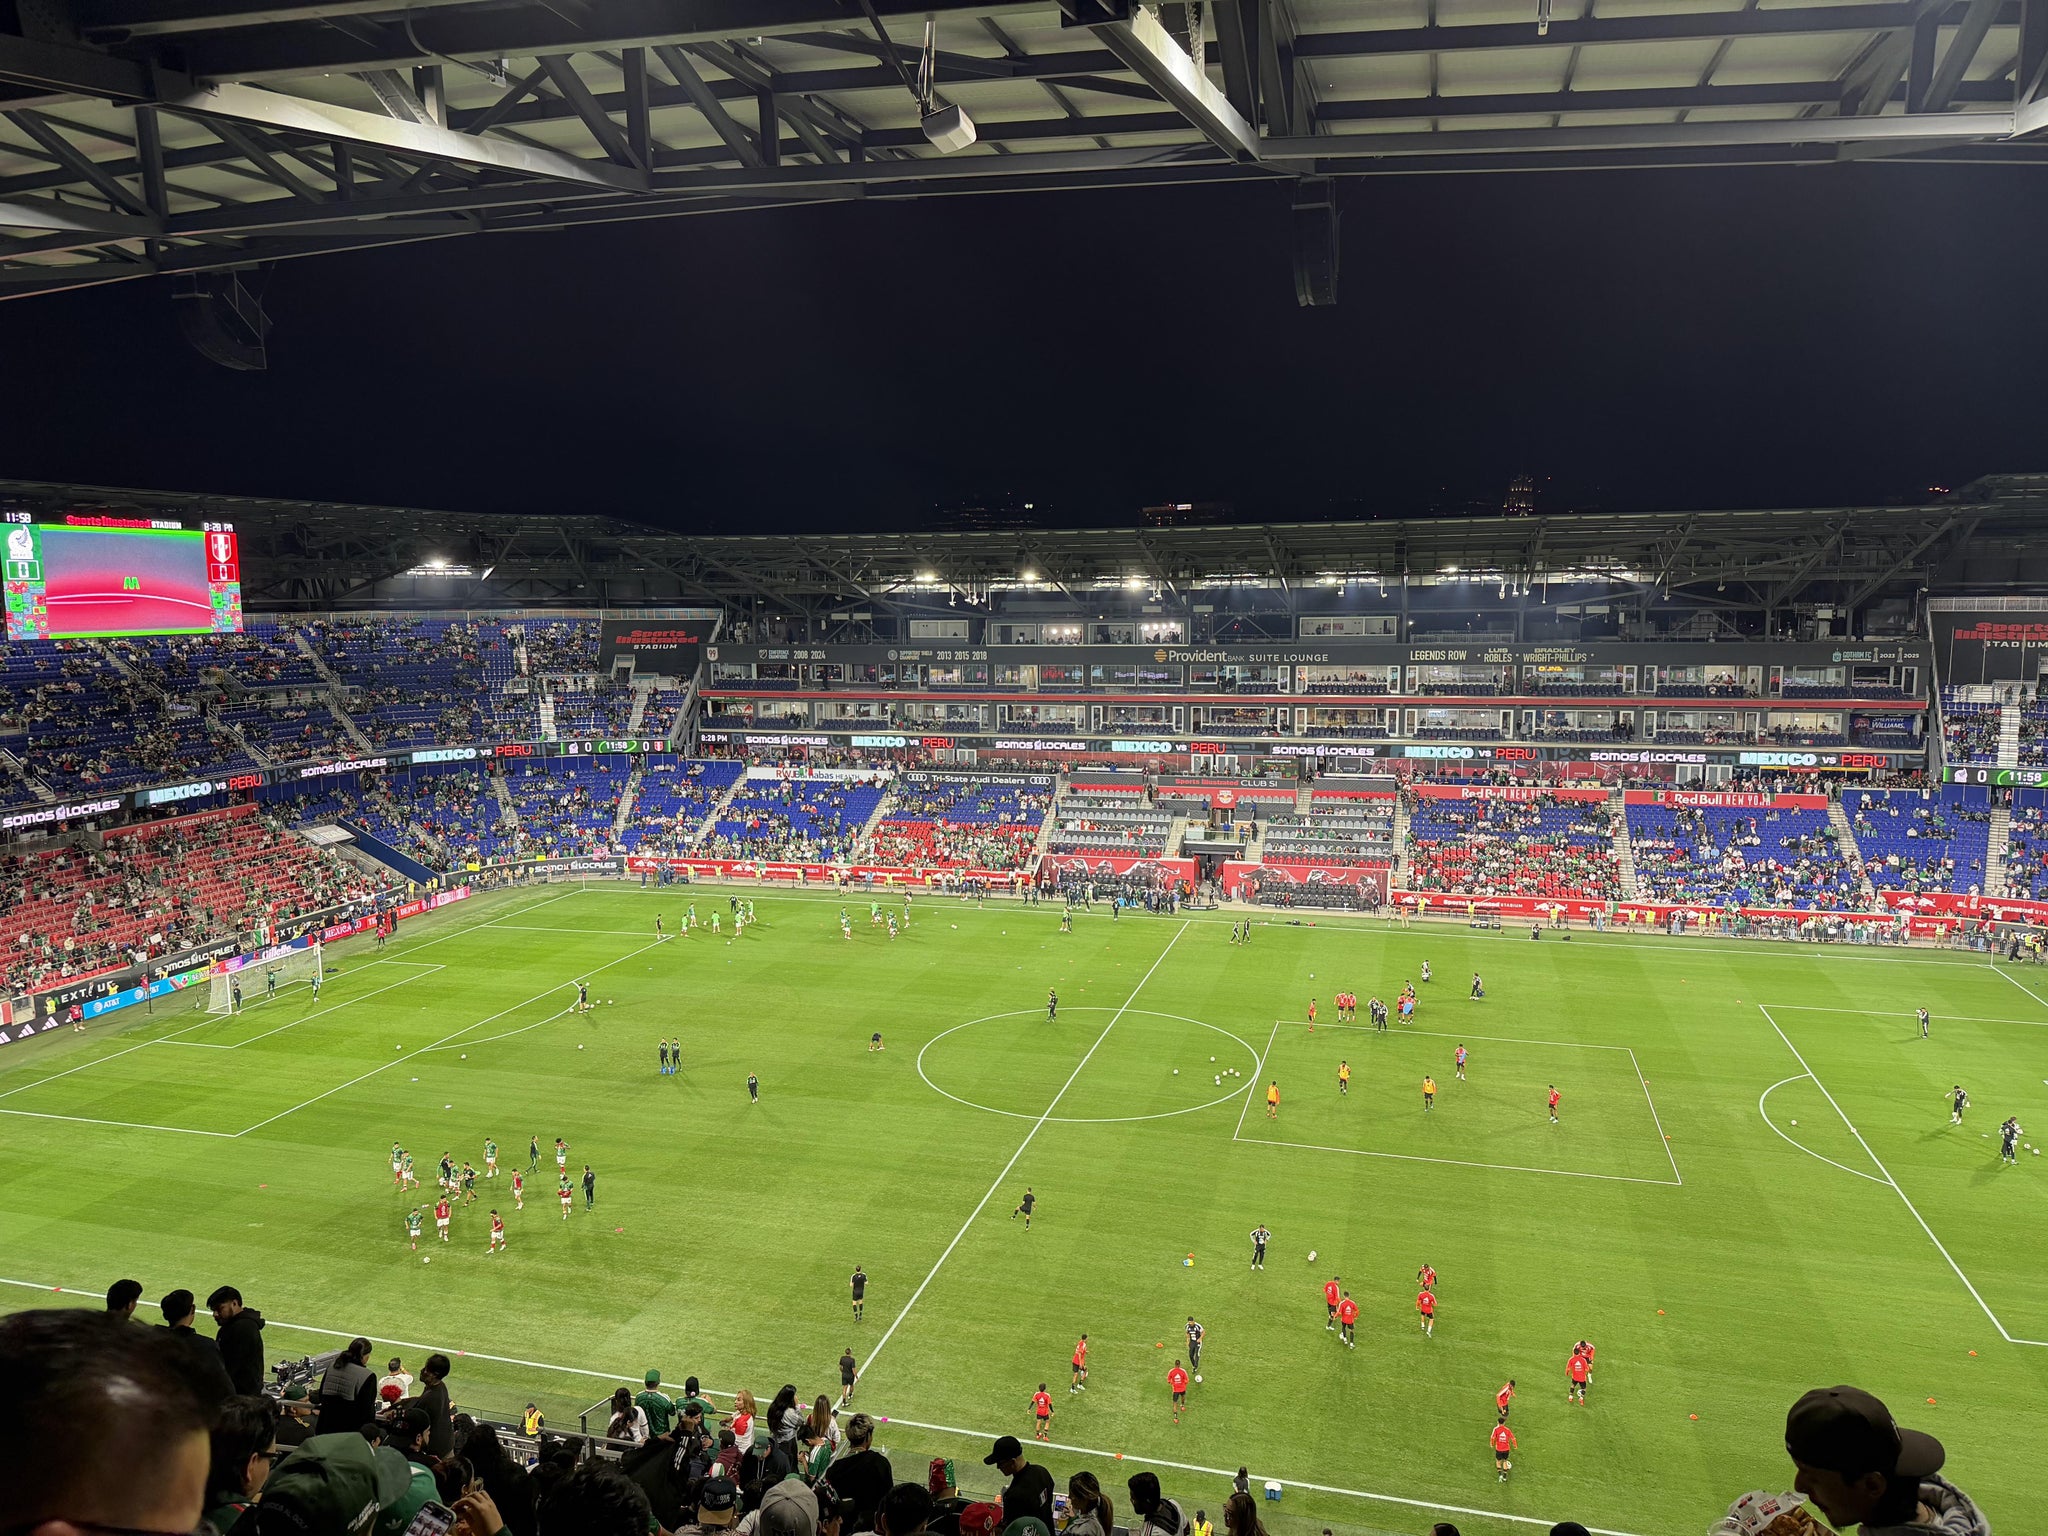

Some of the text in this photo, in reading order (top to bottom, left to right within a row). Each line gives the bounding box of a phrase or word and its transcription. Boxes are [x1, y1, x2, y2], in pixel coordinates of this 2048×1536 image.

[67, 514, 182, 530] Sports Illustrated STADIUM
[630, 630, 686, 638] Sports
[616, 636, 698, 644] Illustrated
[794, 650, 826, 660] 2008 2024
[936, 651, 988, 660] 2013 2015 2018
[1169, 649, 1228, 662] Provident
[1249, 654, 1329, 662] SUITE LOUNGE
[1410, 650, 1468, 661] LEGENDS ROW
[1484, 652, 1513, 662] ROBLES
[1523, 652, 1588, 663] WRIGHT-PHILLIPS
[701, 734, 728, 742] 8:28 PM
[746, 736, 828, 745] SOMOS LOCALES
[851, 736, 906, 748] MEXICO
[922, 738, 954, 749] PERU
[606, 740, 628, 752] 11:58
[995, 741, 1086, 750] SOMOS LOCALES
[1112, 741, 1172, 754] MEXICO
[1190, 742, 1226, 754] PERU
[1272, 746, 1375, 756] SOMOS LOCALES
[412, 747, 475, 763] MEXICO
[496, 744, 532, 758] PERU
[1404, 746, 1474, 759] MEXICO
[1496, 748, 1537, 760] PERU
[1590, 752, 1707, 764] SOMOS LOCALES
[1740, 752, 1817, 766] MEXICO
[1841, 754, 1886, 768] PERU
[301, 757, 387, 778] SOMOS LOCALES
[970, 776, 990, 784] Audi
[992, 777, 1025, 785] Dealers
[1977, 770, 2042, 783] 0 11:58
[1174, 778, 1278, 788] Sports Illustrated CLUB SI
[149, 780, 212, 804] MEXICO
[230, 774, 262, 790] PERU
[1461, 788, 1485, 799] Red
[1486, 788, 1506, 800] Bull
[1510, 789, 1528, 800] NEW
[1674, 793, 1698, 804] Red
[1699, 794, 1722, 805] Bull
[1726, 794, 1745, 805] NEW
[2, 800, 120, 828] SOMOS LOCALES
[202, 814, 220, 824] STATE
[578, 862, 618, 870] LOCALES
[400, 903, 420, 916] DEPOT
[262, 944, 292, 960] Gillette
[104, 997, 120, 1008] AT&T
